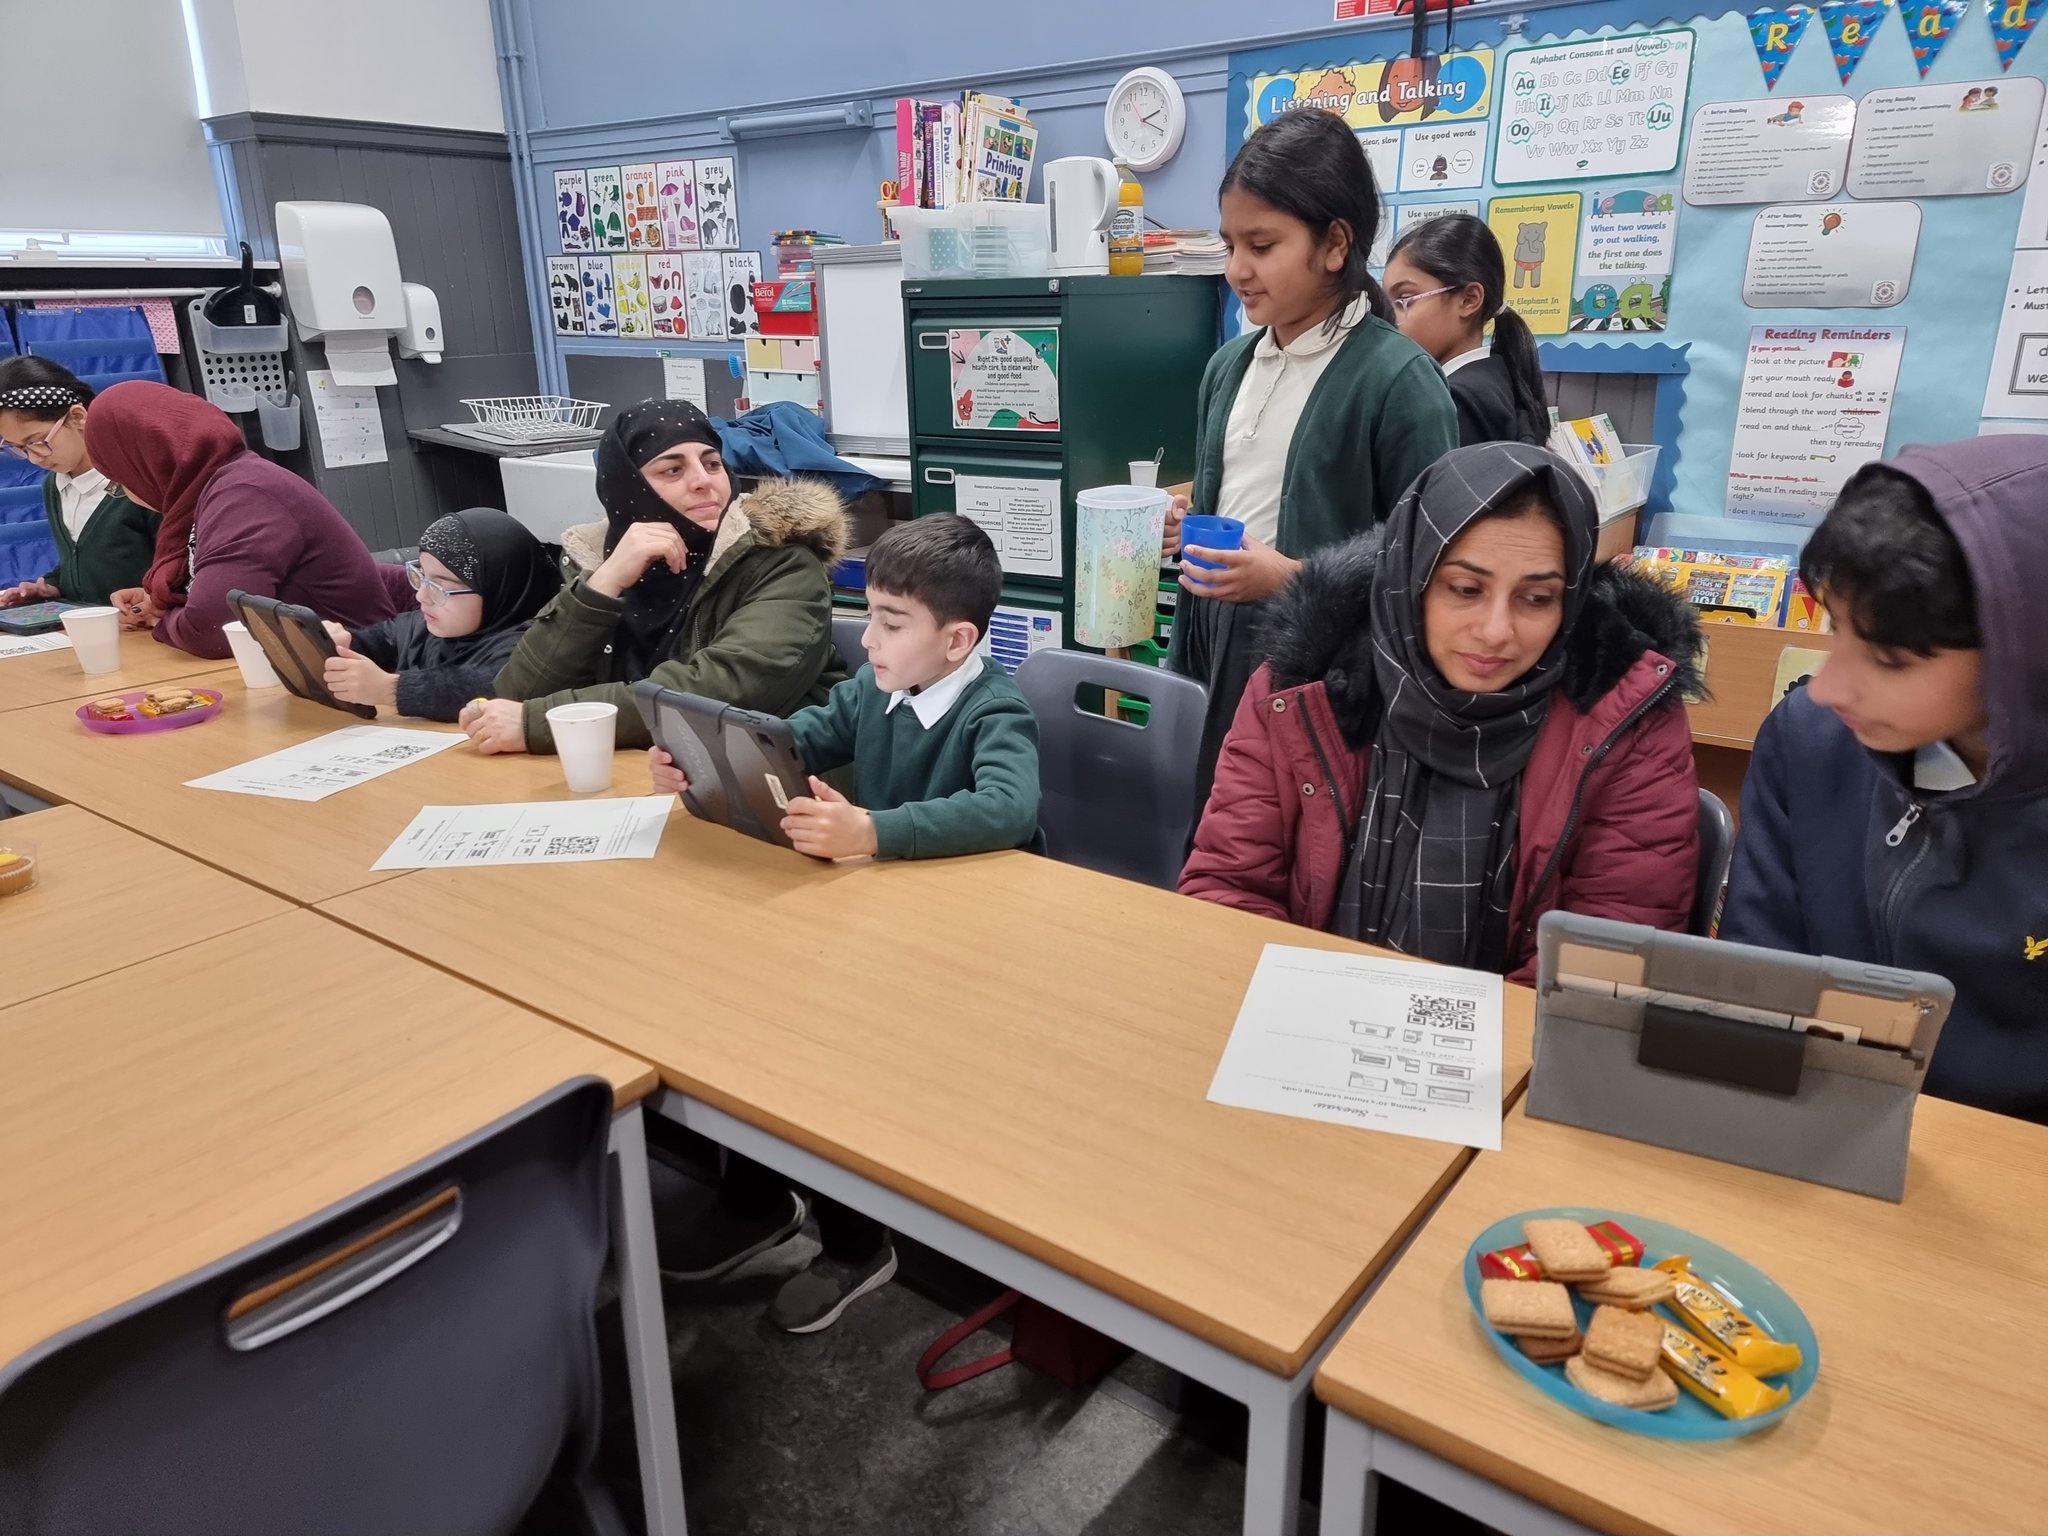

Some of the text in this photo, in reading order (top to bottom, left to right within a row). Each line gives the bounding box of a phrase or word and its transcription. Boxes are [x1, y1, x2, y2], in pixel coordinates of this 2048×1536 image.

[2003, 0, 2027, 28] d
[1919, 15, 1941, 36] a
[1766, 23, 1789, 51] R
[1842, 22, 1861, 44] e
[1530, 41, 1668, 65] Alphabet Consonant and Vowels
[1516, 61, 1678, 90] Aa Bb Cc Dd Ee Ff Gg
[1129, 93, 1137, 101] 11
[1140, 88, 1148, 97] 12
[1357, 84, 1391, 105] and
[1398, 80, 1467, 102] Talking
[1515, 85, 1672, 114] Hh Ii Jj Kk Ll Mm Nn
[1123, 104, 1131, 112] 10
[1119, 118, 1125, 126] 9
[1511, 110, 1671, 137] Oo Pp Qq Rr Ss Tt Uu
[1123, 131, 1129, 139] 8
[1382, 136, 1398, 145] slow
[1415, 128, 1477, 143] Use good words
[944, 127, 952, 165] Draw
[1526, 135, 1649, 158] Vv Ww Xx Yy Zz
[985, 151, 1023, 180] Printing
[625, 170, 653, 184] orange
[666, 166, 685, 182] pink
[705, 165, 724, 179] grey
[559, 175, 582, 189] purple
[593, 173, 615, 186] green
[1495, 202, 1574, 214] Remembering Vowels
[1407, 210, 1421, 219] Use
[1423, 210, 1441, 219] your
[1591, 222, 1666, 233] When two vowels
[1593, 238, 1604, 247] go
[1623, 234, 1660, 246] walking,
[1588, 250, 1602, 258] the
[1603, 249, 1622, 260] first
[1642, 249, 1663, 257] does
[551, 261, 575, 271] brown
[587, 260, 604, 270] blue
[658, 258, 671, 269] red
[729, 257, 754, 268] black
[1599, 261, 1648, 272] the talking.
[755, 287, 774, 297] Berol
[1517, 297, 1548, 307] Elephant
[1518, 308, 1560, 317] Underpants
[1765, 329, 1891, 343] Reading Reminders
[1000, 356, 1012, 364] good
[1799, 358, 1826, 369] picture
[997, 373, 1009, 381] good
[1751, 375, 1762, 384] get
[1766, 376, 1782, 385] your
[1813, 375, 1836, 385] ready
[1792, 391, 1809, 399] look
[1811, 391, 1823, 401] for
[1826, 392, 1853, 400] chunks
[1768, 407, 1799, 416] through
[1830, 439, 1841, 448] try
[1844, 440, 1882, 450] rereading
[1756, 452, 1768, 461] for
[1771, 453, 1807, 462] keywords
[1734, 484, 1817, 498] does what I'm reading
[1733, 493, 1755, 502] right?
[1732, 507, 1748, 515] does
[1759, 509, 1779, 517] make
[1781, 511, 1805, 519] sense?
